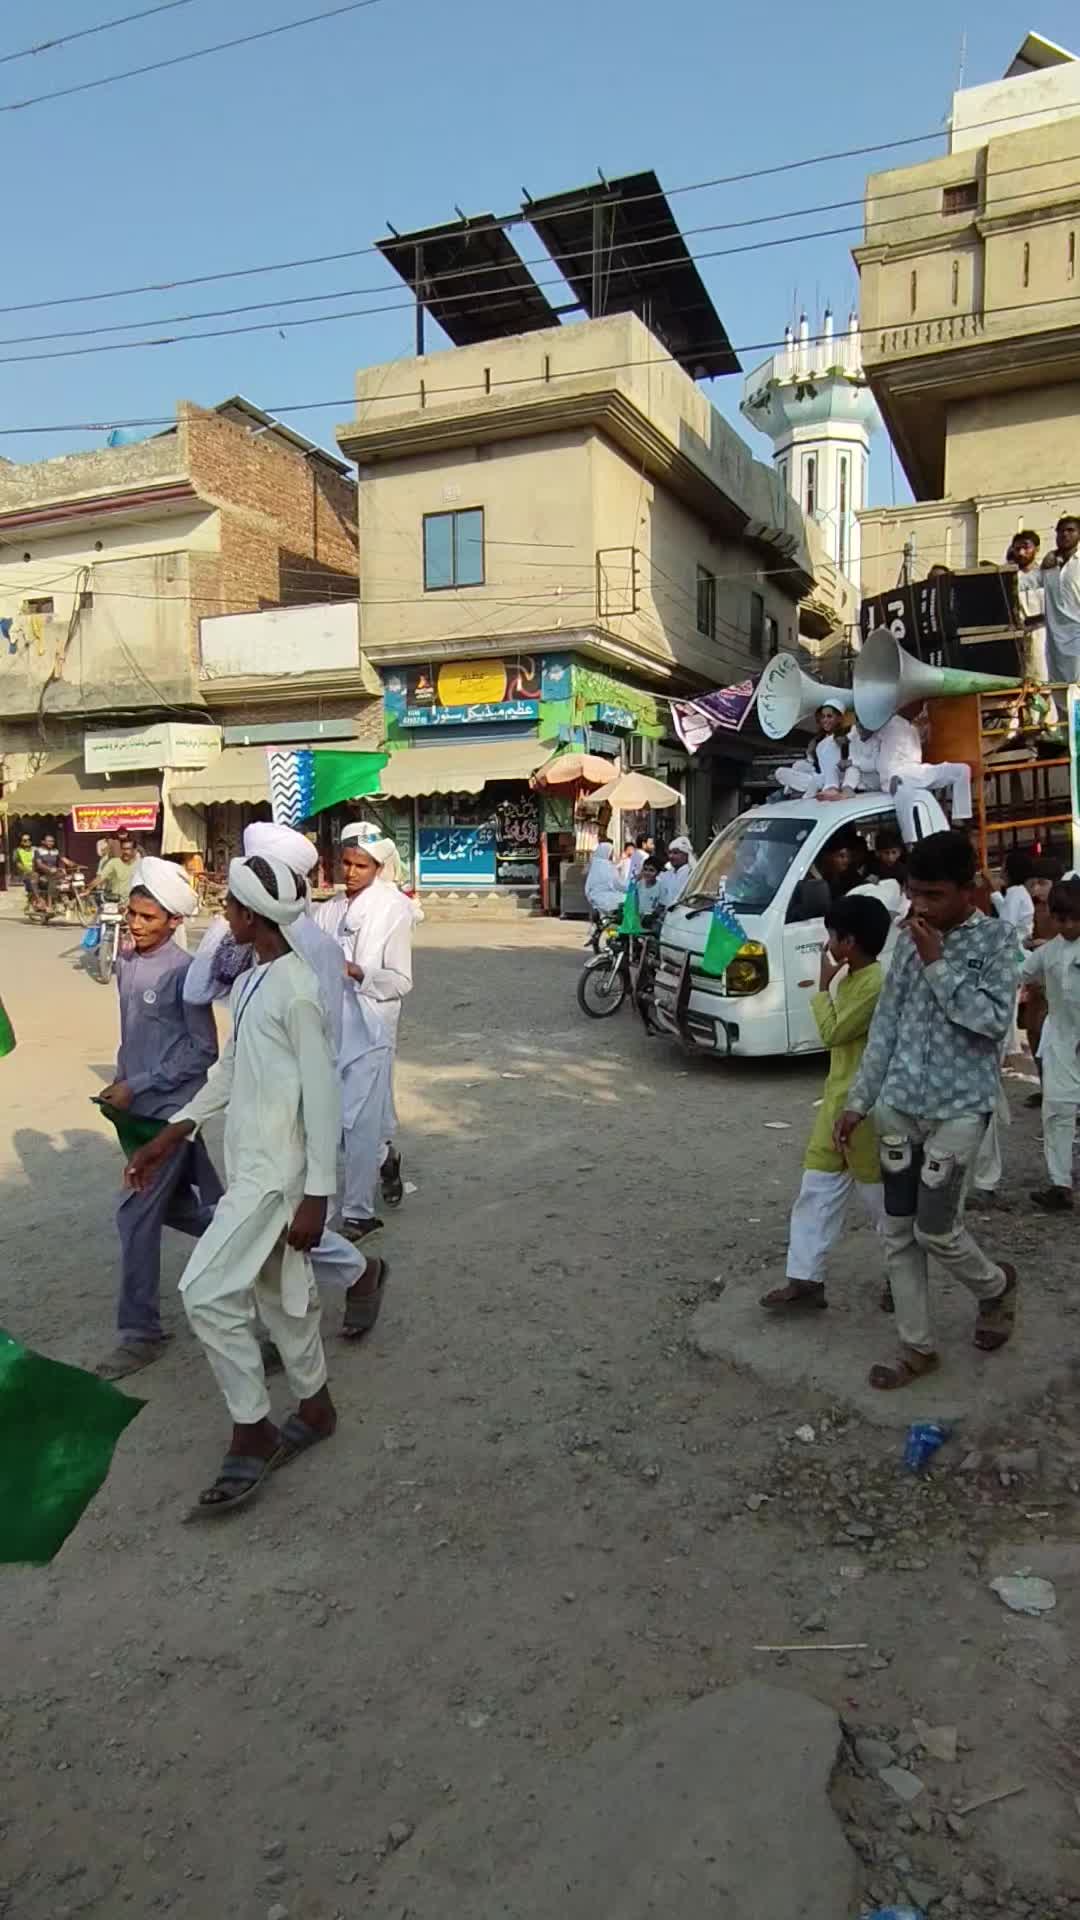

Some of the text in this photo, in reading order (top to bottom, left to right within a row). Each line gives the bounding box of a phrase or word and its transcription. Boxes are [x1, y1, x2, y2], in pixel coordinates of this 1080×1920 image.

[462, 702, 506, 721] میڈیکل
[504, 700, 534, 720] عظیم
[438, 831, 472, 860] میڈیکل
